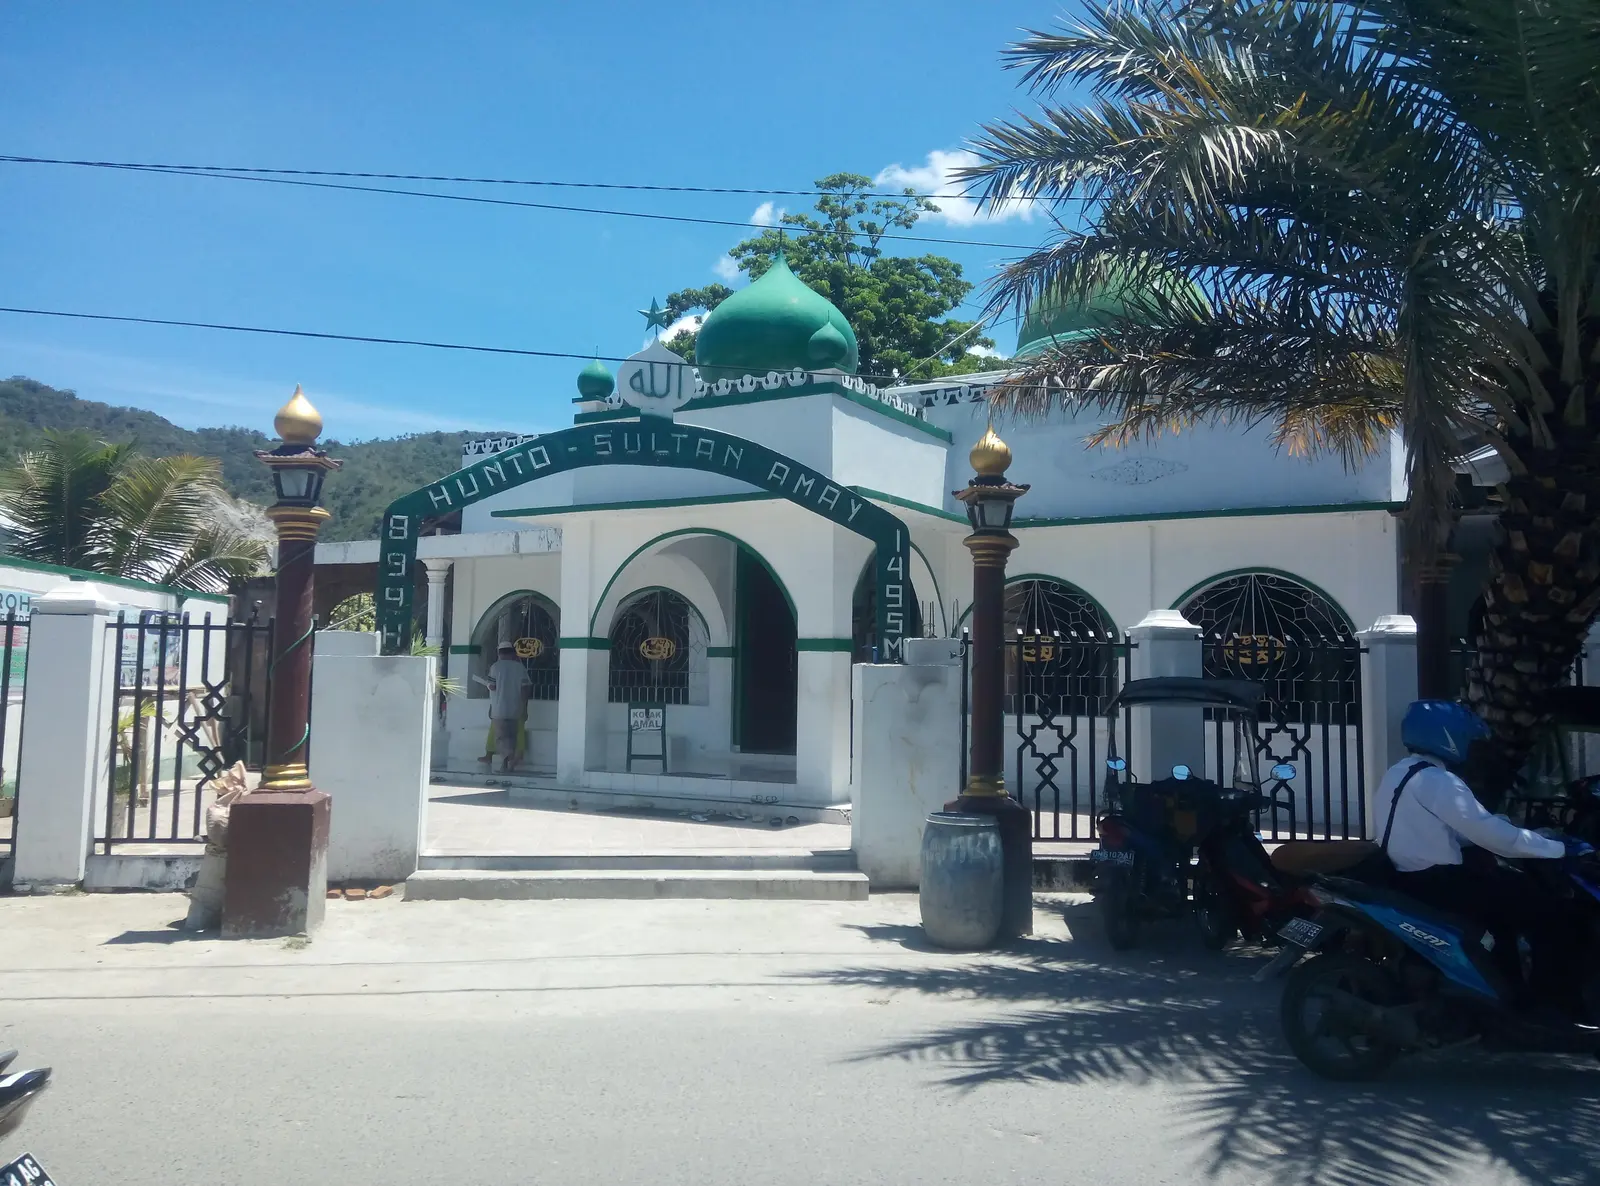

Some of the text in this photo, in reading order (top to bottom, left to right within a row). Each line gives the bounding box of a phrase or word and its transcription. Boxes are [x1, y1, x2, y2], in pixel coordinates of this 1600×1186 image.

[593, 433, 744, 470] SULTAN
[767, 461, 863, 523] AMAY
[632, 711, 662, 719] KOAK
[632, 720, 662, 729] AMAL
